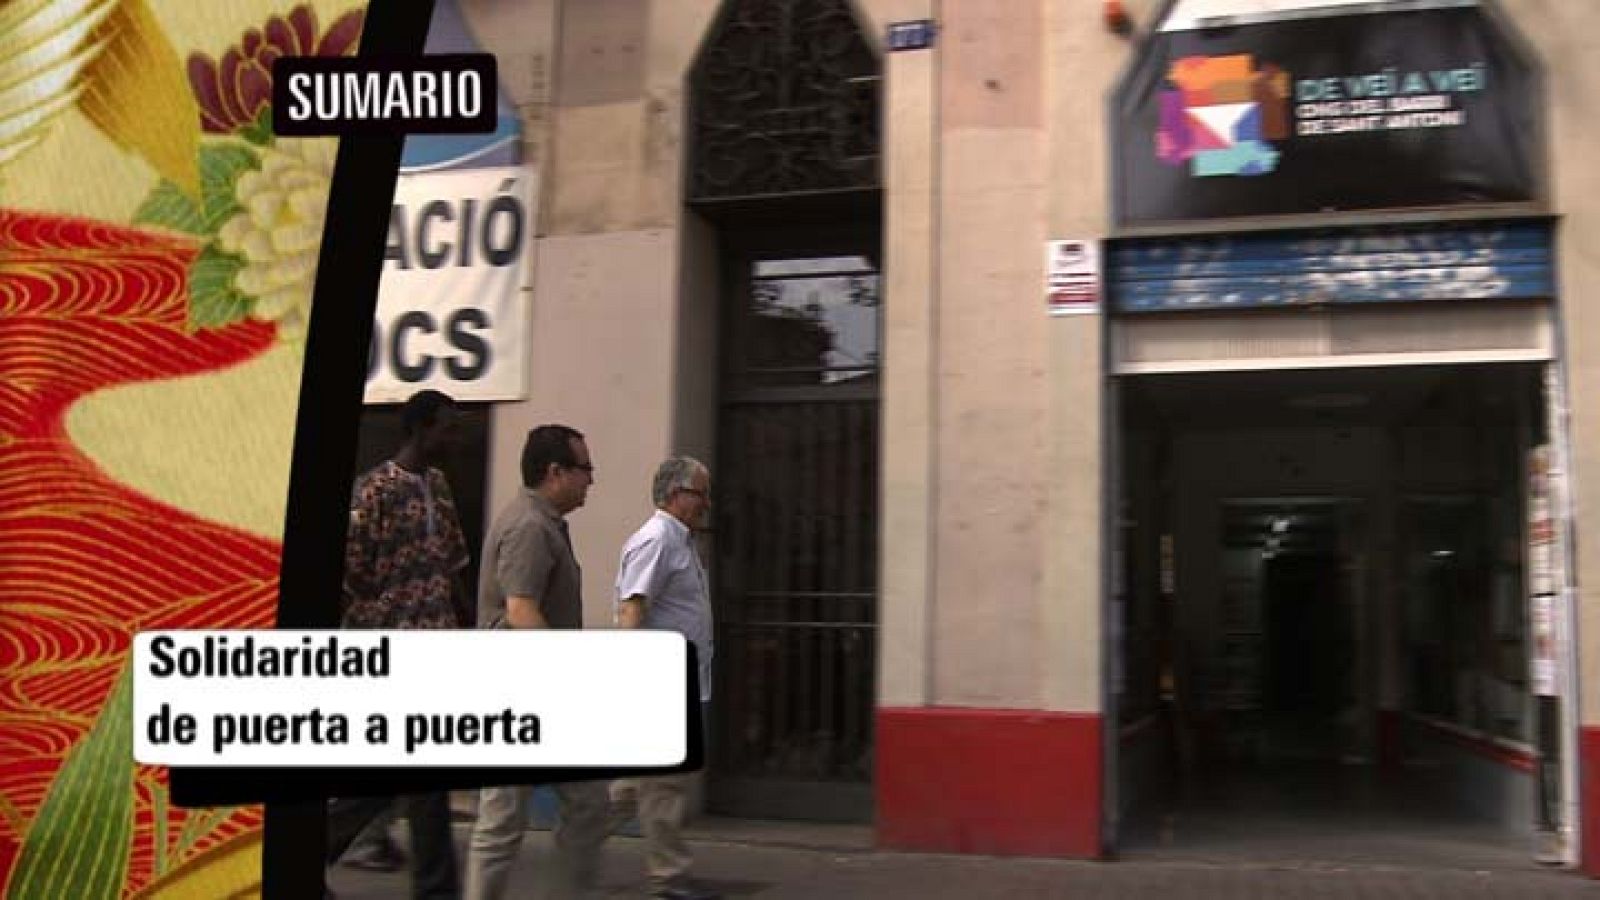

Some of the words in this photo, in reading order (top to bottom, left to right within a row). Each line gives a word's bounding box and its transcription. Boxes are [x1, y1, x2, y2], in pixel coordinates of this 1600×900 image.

[1296, 78, 1344, 100] DE
[1401, 71, 1429, 93] A
[367, 308, 492, 382] CS
